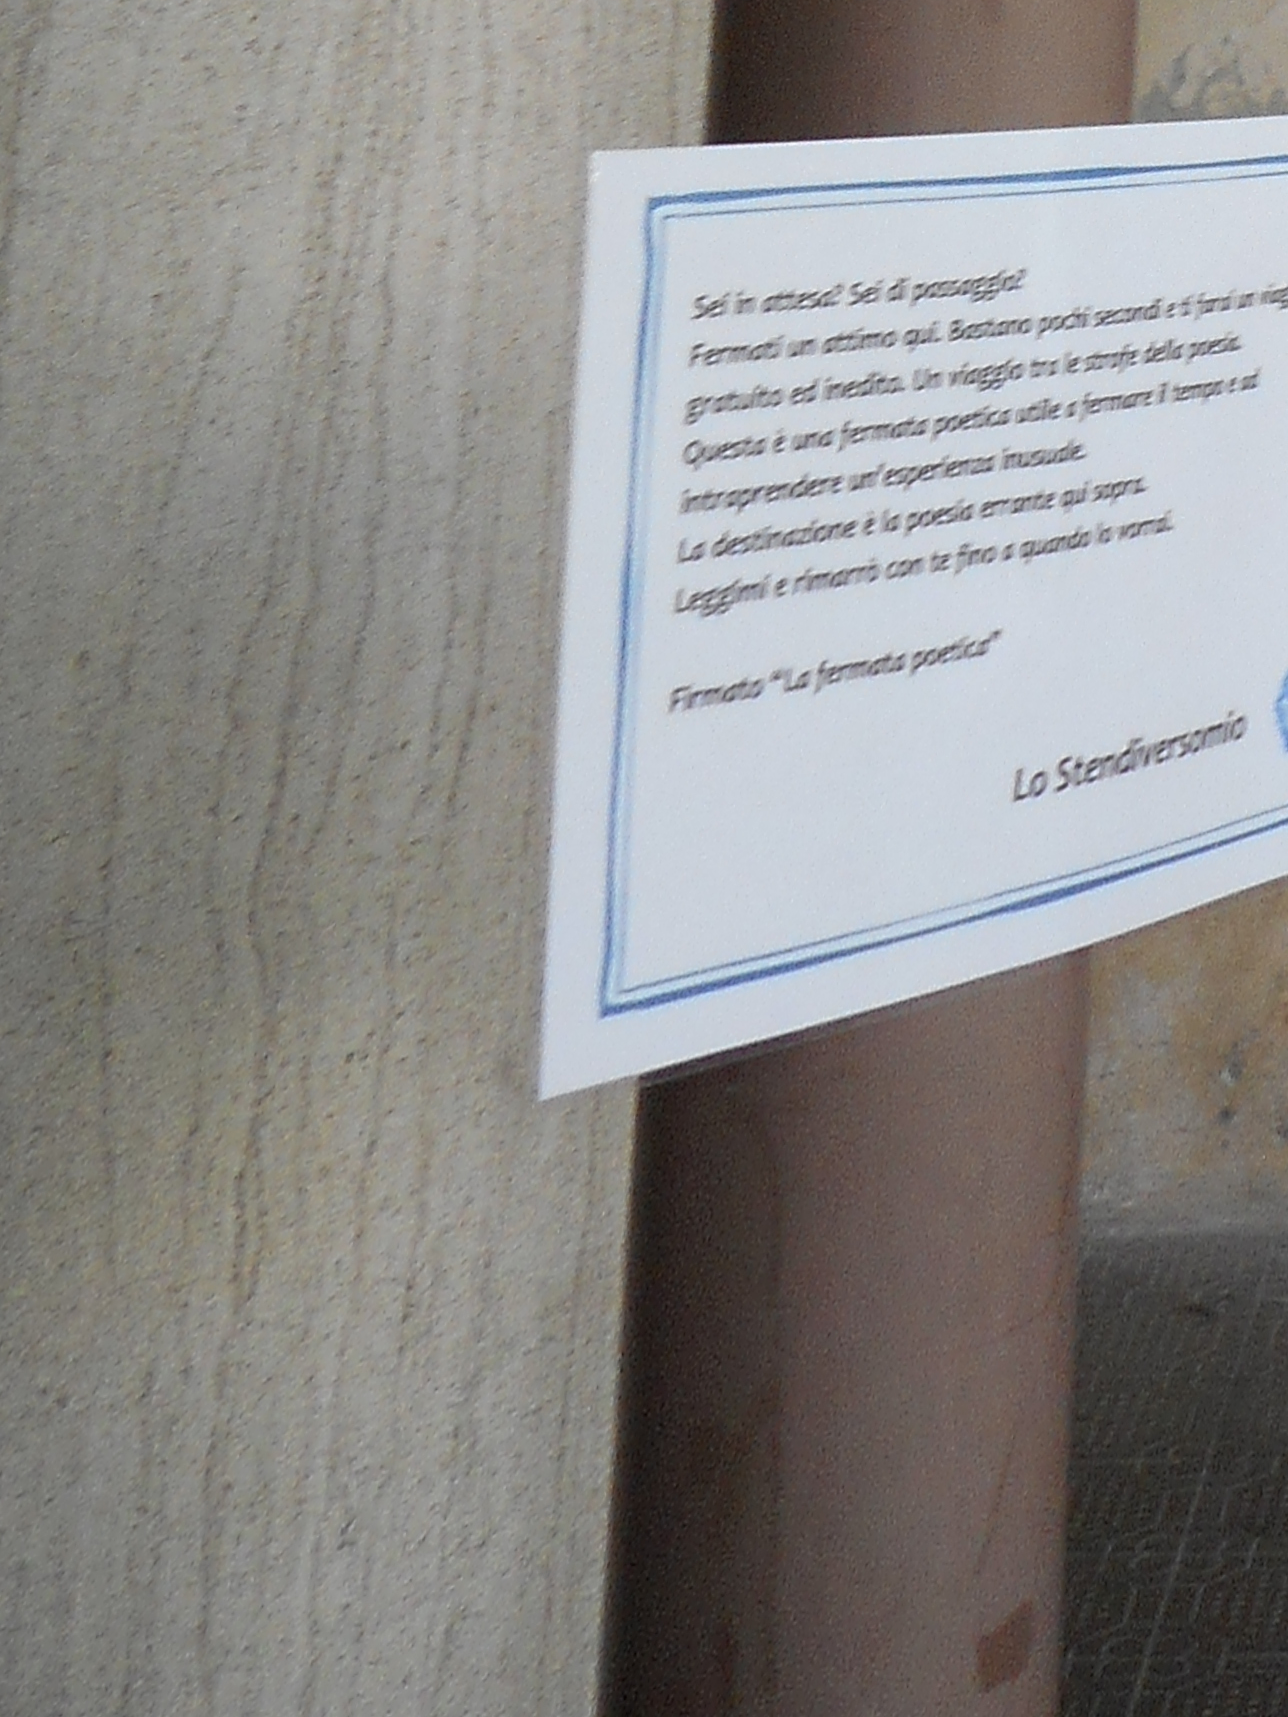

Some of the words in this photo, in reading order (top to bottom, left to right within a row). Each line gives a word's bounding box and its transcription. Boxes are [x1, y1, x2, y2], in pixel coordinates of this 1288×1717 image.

[691, 291, 729, 320] Sei
[733, 290, 756, 315] in
[761, 282, 844, 313] attesa?
[847, 279, 883, 306] Sei
[886, 277, 909, 302] di
[909, 268, 1027, 305] passaggio?
[689, 334, 785, 367] Fermati
[821, 327, 898, 354] attimo
[948, 317, 1032, 342] Bastano
[684, 384, 784, 425] gratuito
[788, 378, 820, 405] ed
[912, 368, 944, 391] Un
[1029, 359, 1059, 378] tra
[1063, 352, 1079, 374] le
[1143, 338, 1184, 364] della
[682, 436, 769, 470] Questa
[790, 429, 835, 451] una
[835, 416, 930, 452] fermata
[930, 405, 1011, 440] poetica
[677, 539, 706, 564] La
[710, 519, 859, 558] destinazione
[880, 509, 902, 533] la
[902, 498, 974, 536] poesia
[979, 491, 1055, 519] errante
[1061, 481, 1091, 511] qui
[680, 473, 843, 514] intraprendere
[673, 573, 773, 618] Leggimi
[883, 556, 925, 580] con
[929, 551, 952, 573] te
[953, 542, 997, 574] fino
[1018, 527, 1093, 563] quando
[668, 677, 765, 713] Firmato
[812, 652, 907, 693] fermata
[1012, 768, 1049, 802] Lo
